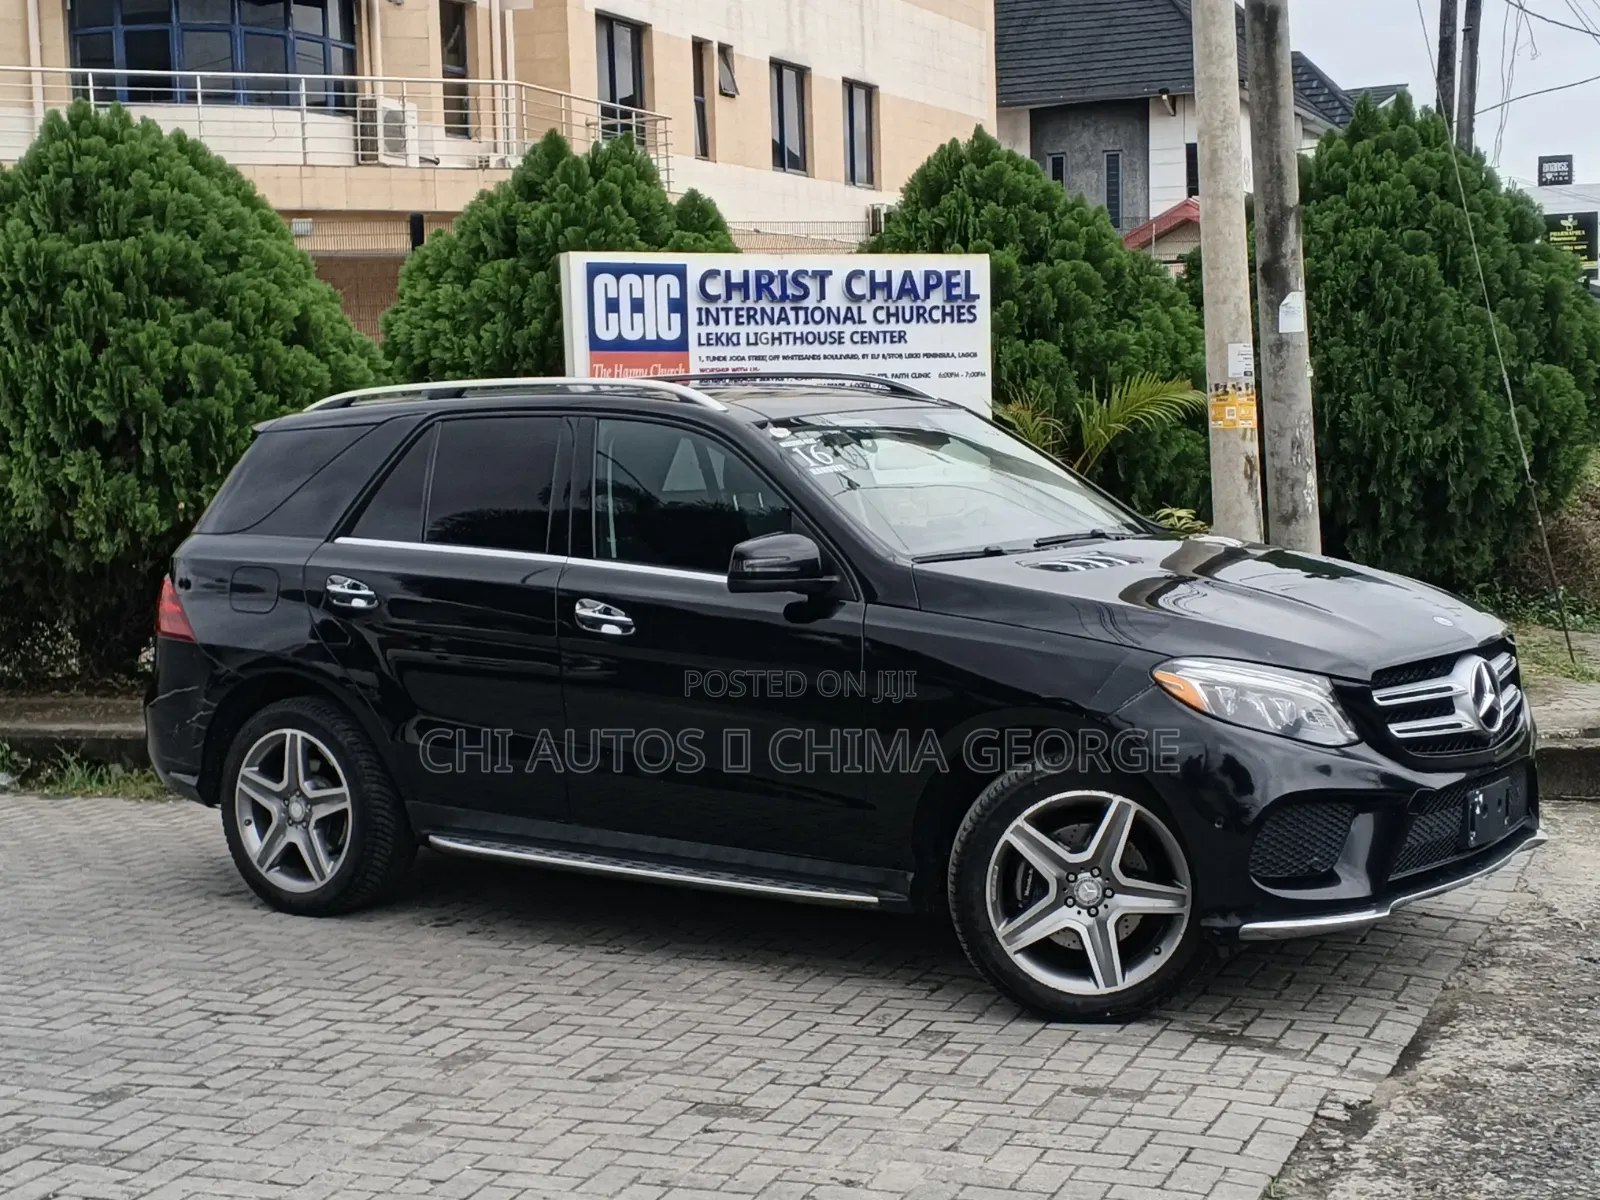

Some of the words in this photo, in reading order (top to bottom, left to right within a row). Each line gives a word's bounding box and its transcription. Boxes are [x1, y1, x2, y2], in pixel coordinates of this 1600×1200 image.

[697, 269, 833, 304] CHRIST
[843, 269, 981, 303] CHAPEL
[593, 273, 682, 341] CCIC
[697, 305, 867, 326] INTERNATIONAL
[872, 304, 977, 325] CHURCHES
[697, 332, 741, 347] LEKKI
[746, 331, 845, 346] LIGHTHOUSE
[850, 330, 908, 345] CENTER
[593, 364, 612, 378] The
[650, 363, 685, 376] Church
[938, 371, 960, 379] 6:00PM
[792, 444, 834, 467] 16
